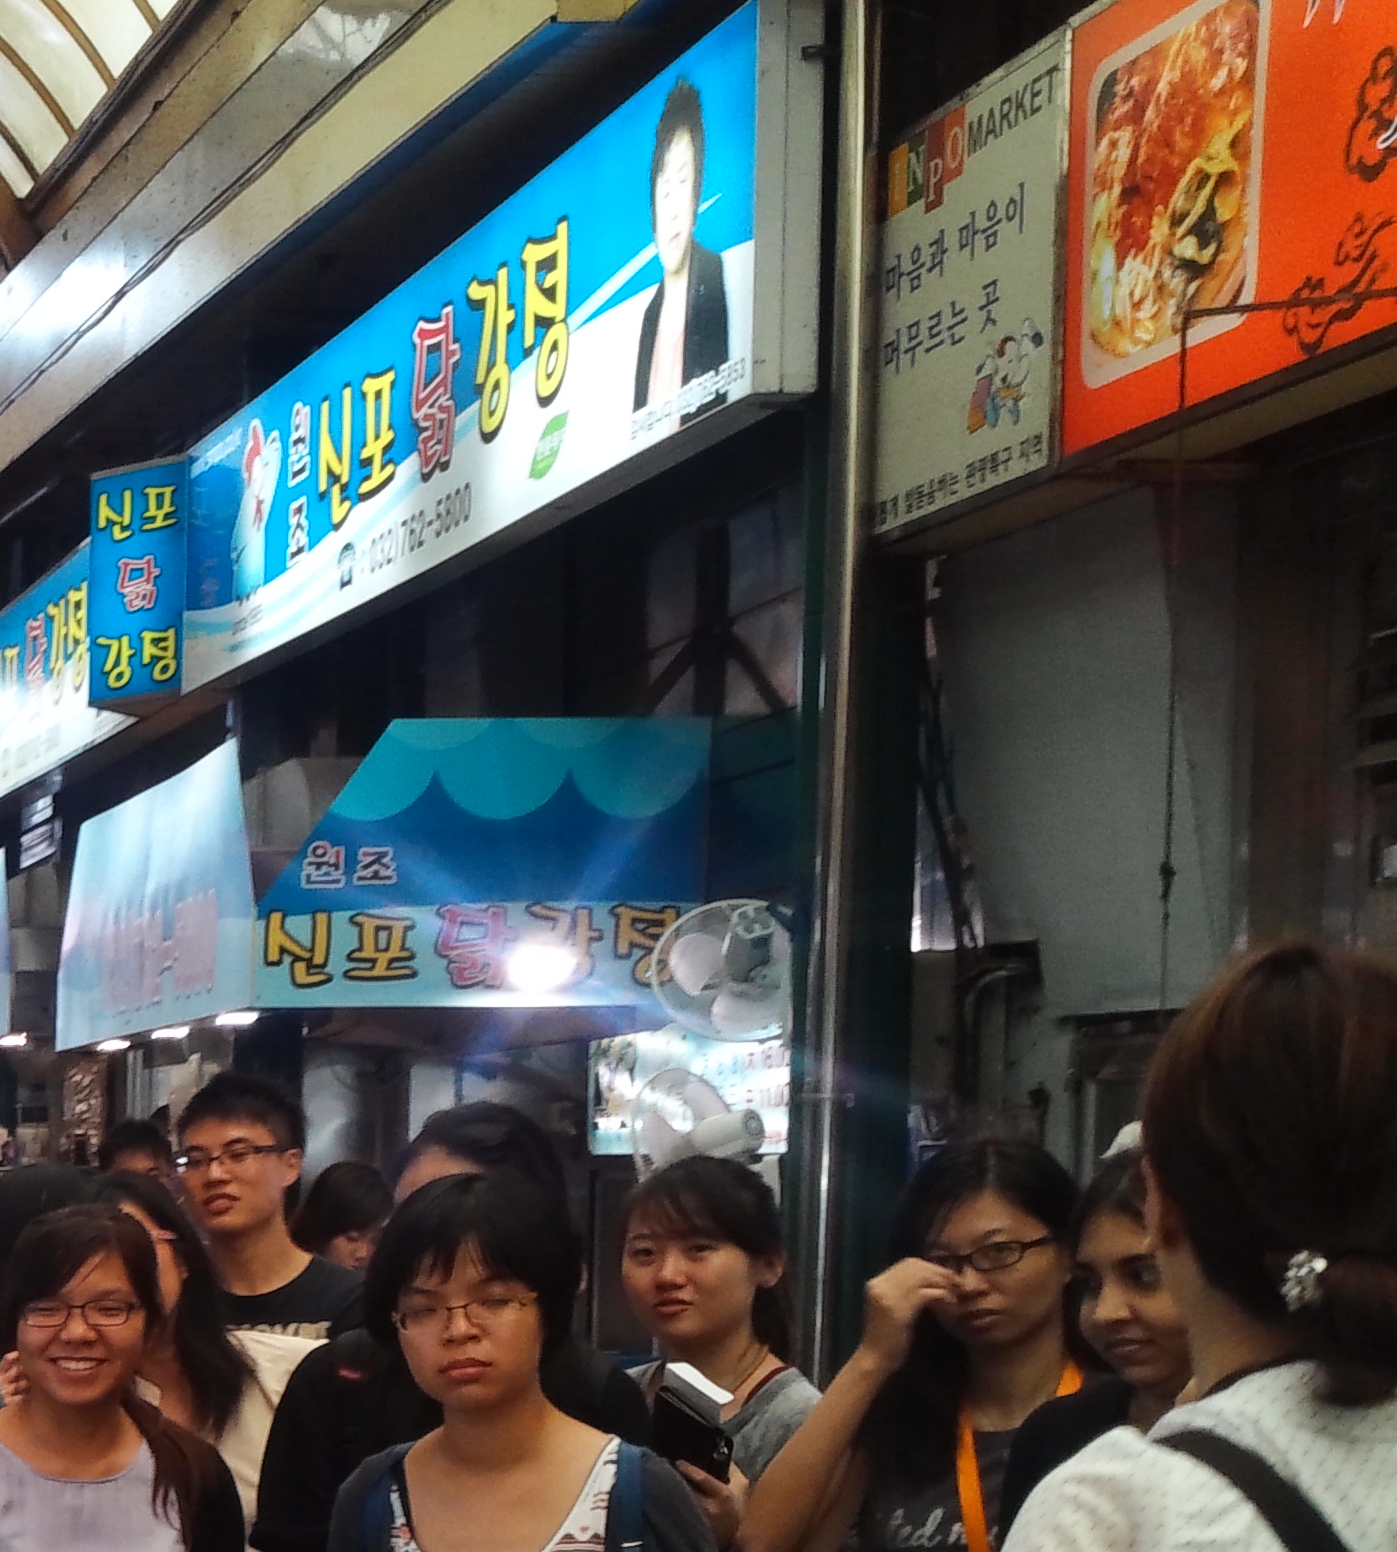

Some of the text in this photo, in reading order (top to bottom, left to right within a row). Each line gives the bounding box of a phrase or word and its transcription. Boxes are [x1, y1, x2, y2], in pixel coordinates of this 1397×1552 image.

[967, 63, 1061, 159] MARKET
[957, 181, 1026, 261] 마음이
[883, 277, 1001, 377] 머무르는 곳
[96, 485, 179, 541] 신포
[117, 556, 161, 613] 닭
[96, 627, 179, 691] 강정
[301, 839, 398, 890] 원조
